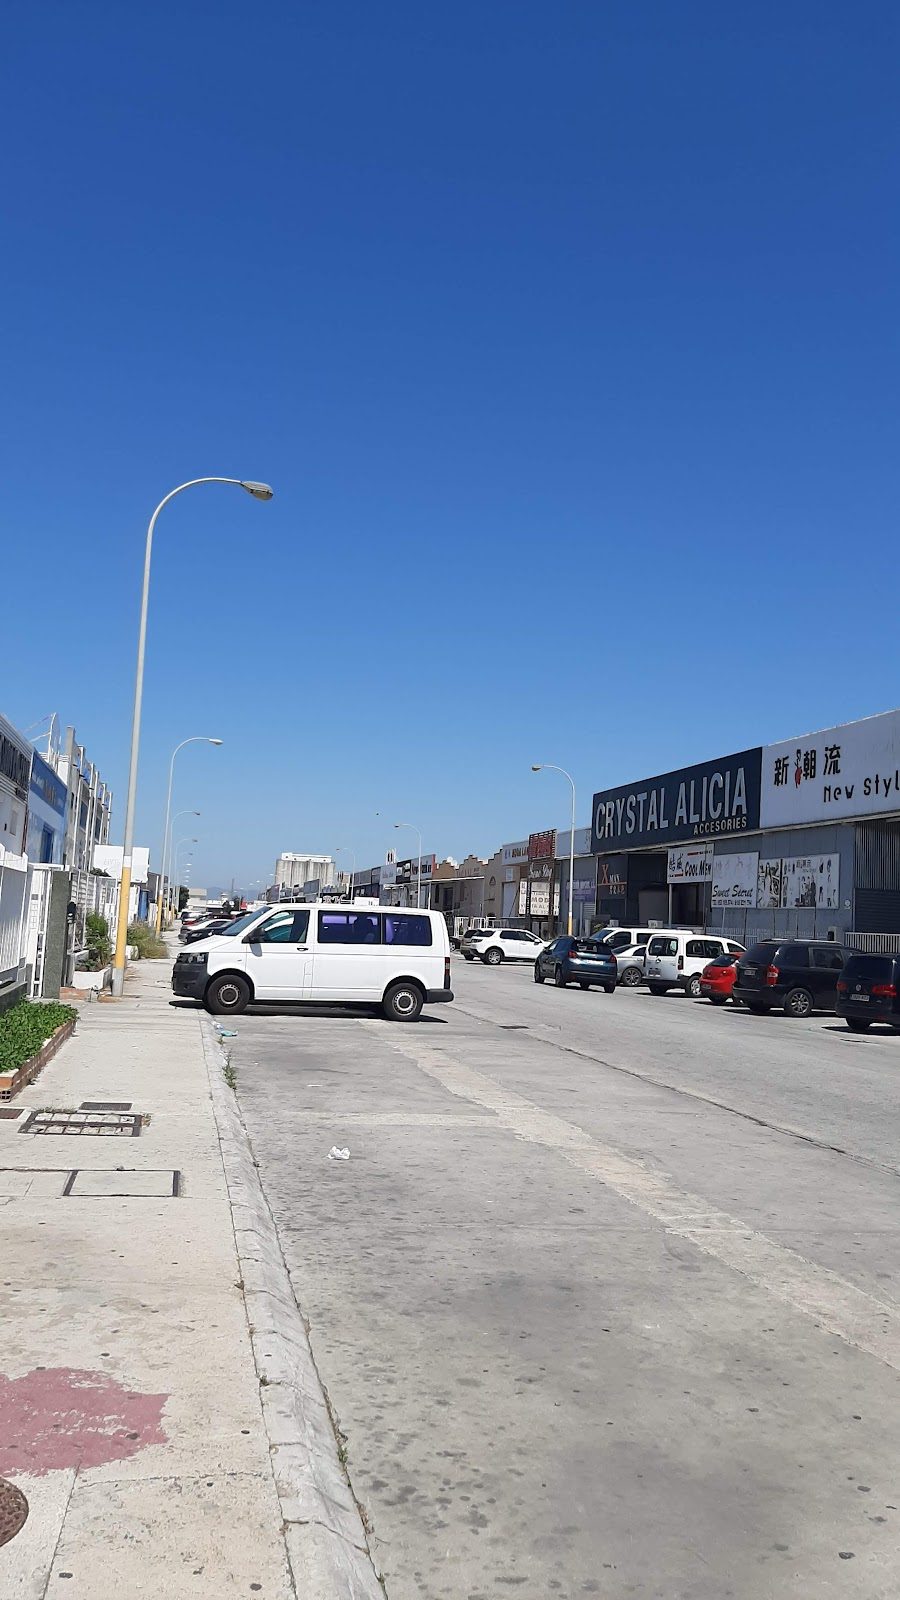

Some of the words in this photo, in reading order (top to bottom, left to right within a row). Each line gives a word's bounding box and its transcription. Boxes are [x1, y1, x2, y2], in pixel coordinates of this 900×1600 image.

[595, 788, 669, 840] CRYSTAL
[675, 767, 747, 826] ALICIA
[823, 785, 855, 803] New
[693, 816, 747, 835] ACCESORIES
